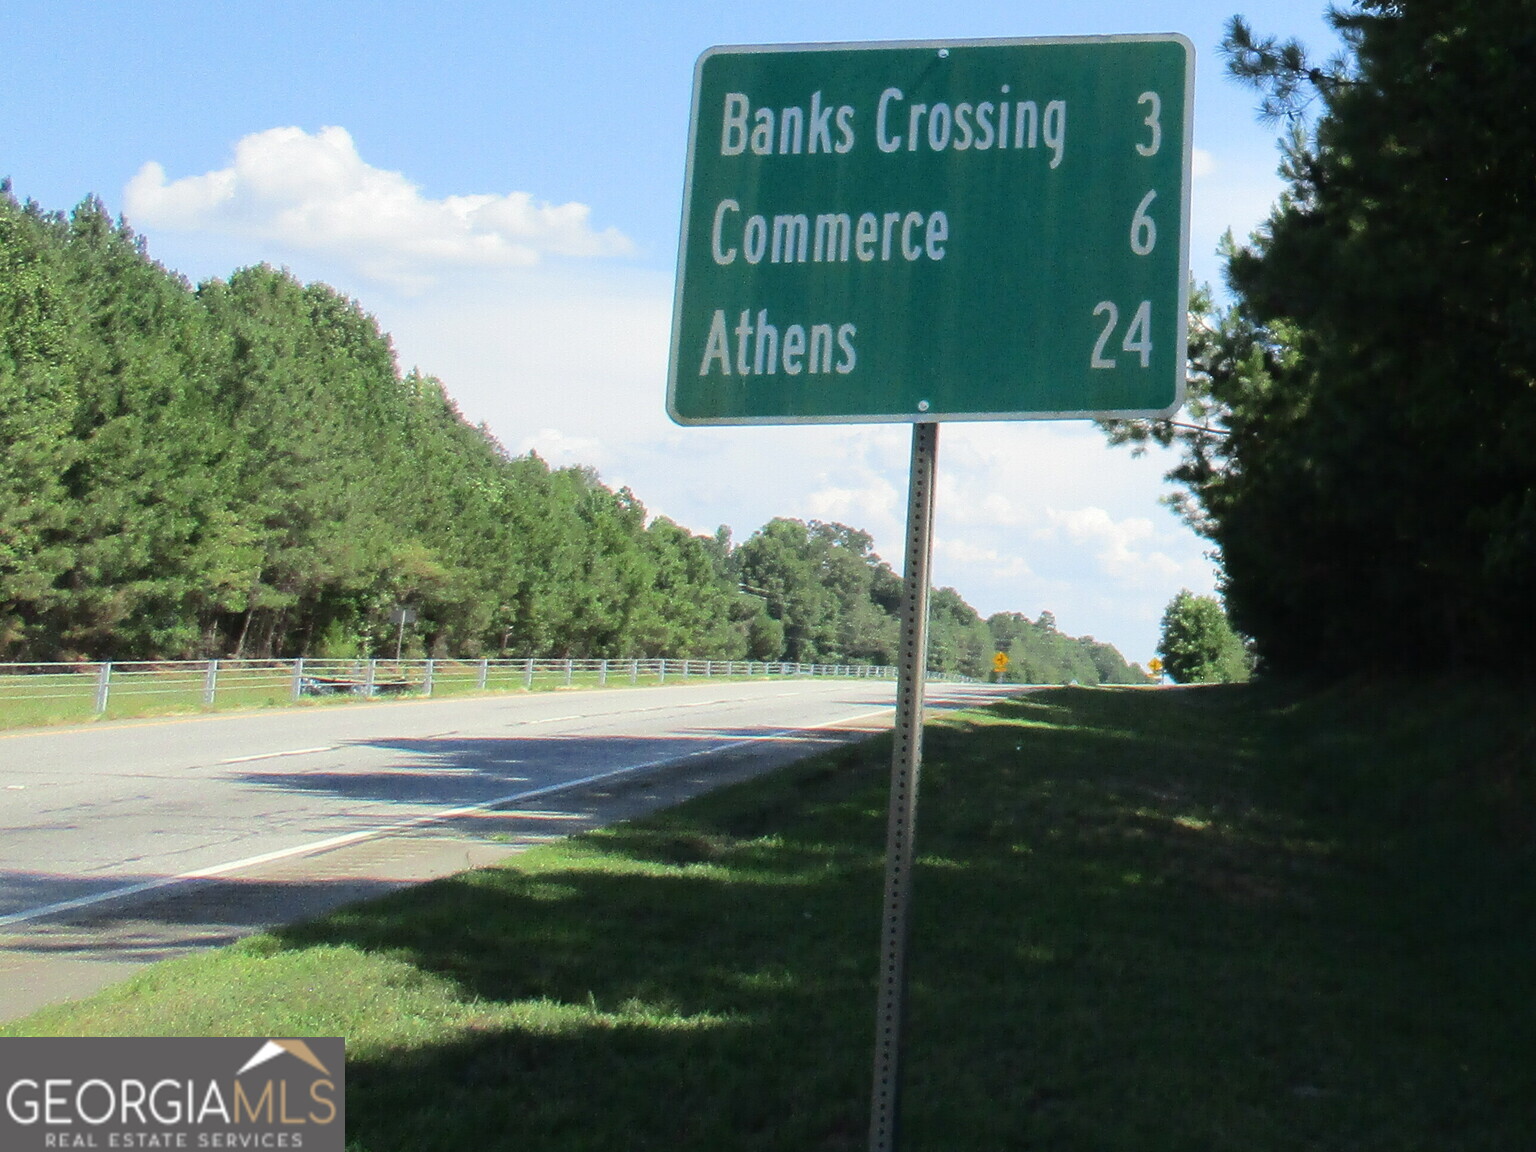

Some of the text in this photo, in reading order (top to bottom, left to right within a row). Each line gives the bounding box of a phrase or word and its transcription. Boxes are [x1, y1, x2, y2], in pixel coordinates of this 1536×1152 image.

[721, 84, 1162, 169] Banks Crossing 3
[712, 190, 1158, 266] Commerce 6
[700, 300, 1153, 376] Athens 24
